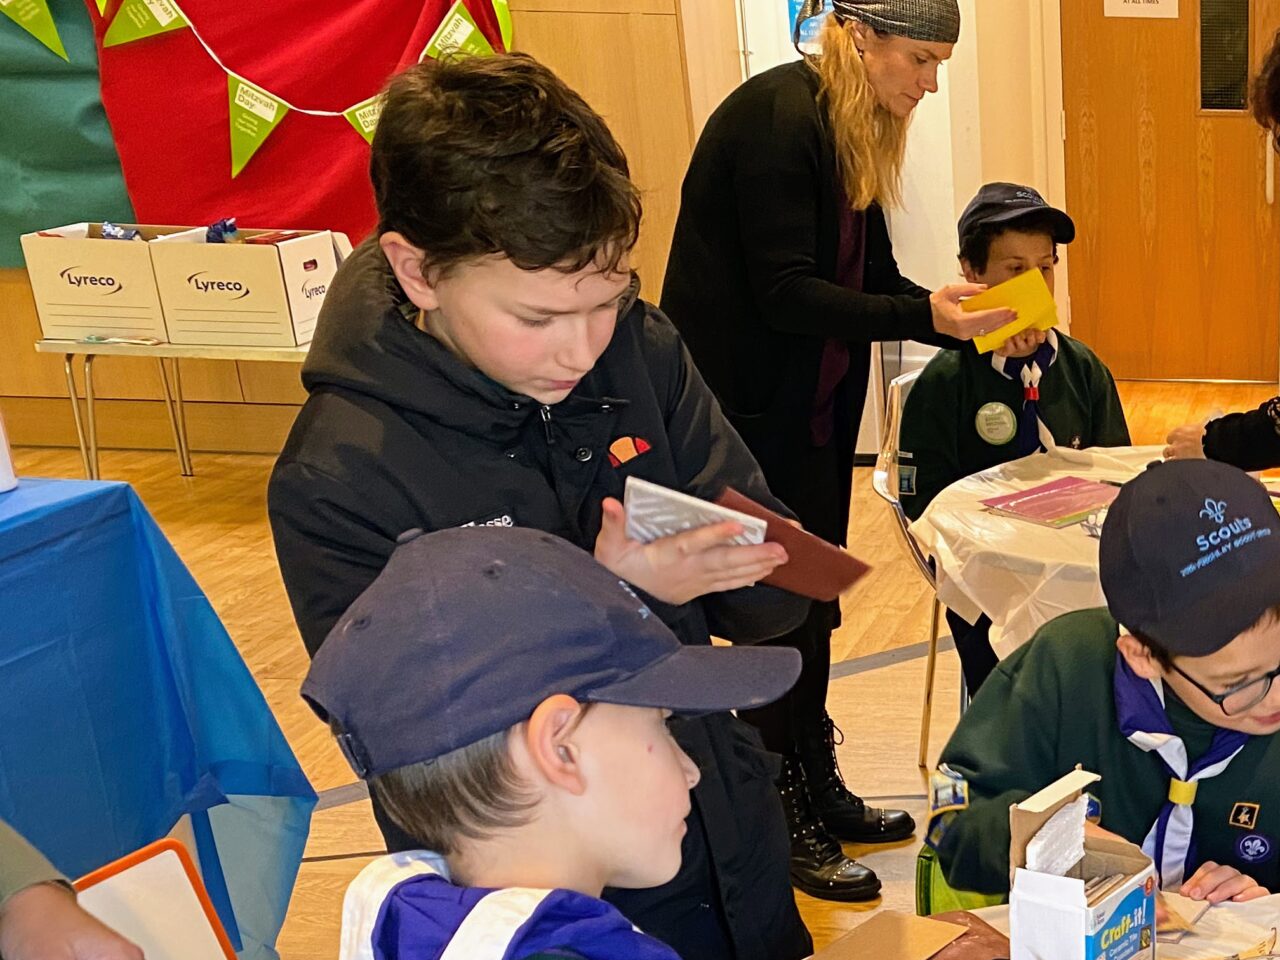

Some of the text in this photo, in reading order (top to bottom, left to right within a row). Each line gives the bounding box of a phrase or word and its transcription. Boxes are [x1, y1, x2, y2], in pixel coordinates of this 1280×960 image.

[237, 94, 255, 110] Day
[239, 86, 276, 112] Mitzvah
[362, 118, 379, 129] Da
[67, 273, 116, 289] Lyreco
[195, 278, 243, 293] Lyreco
[304, 284, 326, 300] Lyreco
[1196, 517, 1252, 551] Scouts
